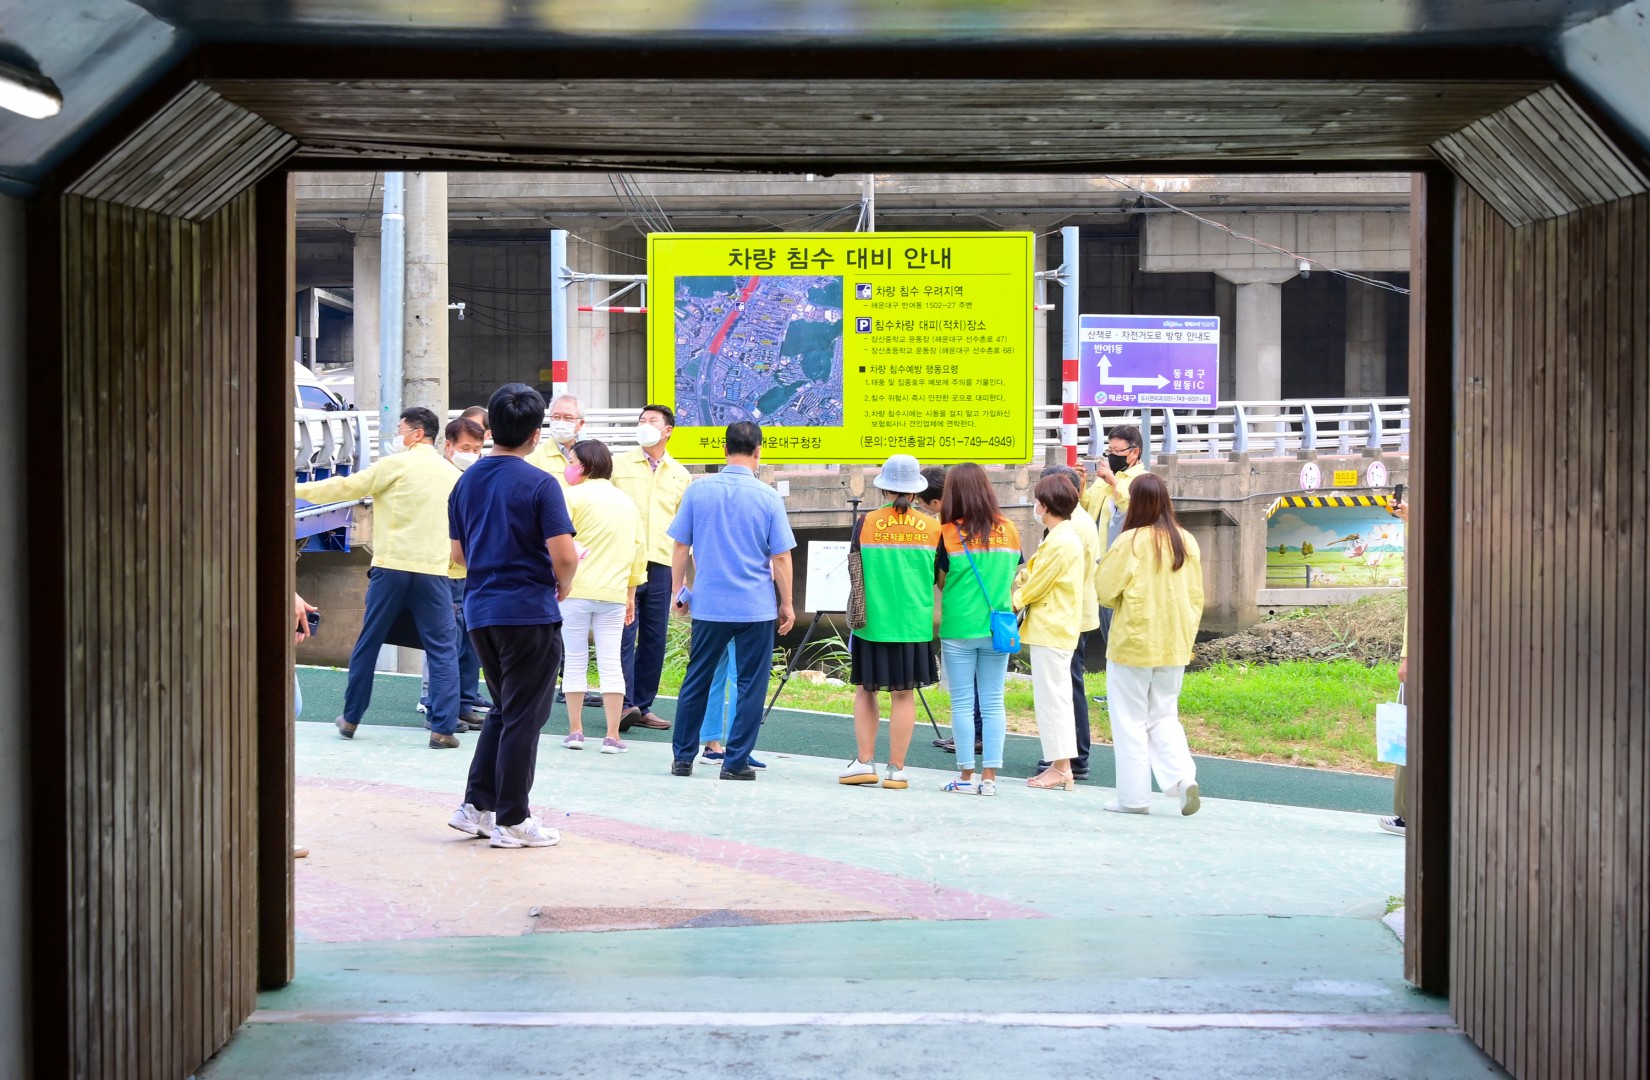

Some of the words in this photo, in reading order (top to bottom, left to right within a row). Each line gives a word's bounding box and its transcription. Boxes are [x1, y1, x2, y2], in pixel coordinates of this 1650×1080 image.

[728, 248, 776, 270] 차량
[786, 248, 835, 270] 침수
[846, 248, 892, 270] 대비
[904, 248, 951, 270] 안내
[876, 285, 895, 297] 차량
[900, 285, 919, 297] 침수
[924, 285, 963, 297] 우려지역
[874, 320, 914, 332] 침수차량
[920, 320, 986, 332] 대피(적치)장소
[1088, 330, 1112, 340] 산책로
[1122, 331, 1162, 341] 자전거도로
[1166, 332, 1182, 342] 방향
[1186, 332, 1211, 342] 안내도
[1094, 344, 1122, 354] 반여1동
[870, 365, 886, 374] 차량
[890, 365, 922, 374] 침수예방
[926, 365, 958, 374] 행동요령
[1173, 380, 1205, 390] 원동IC
[860, 436, 936, 448] (문의:안전총괄과
[940, 436, 1016, 448] 051-749-4949)
[875, 514, 927, 531] CAIND
[874, 532, 928, 542] 전국자율방재단
